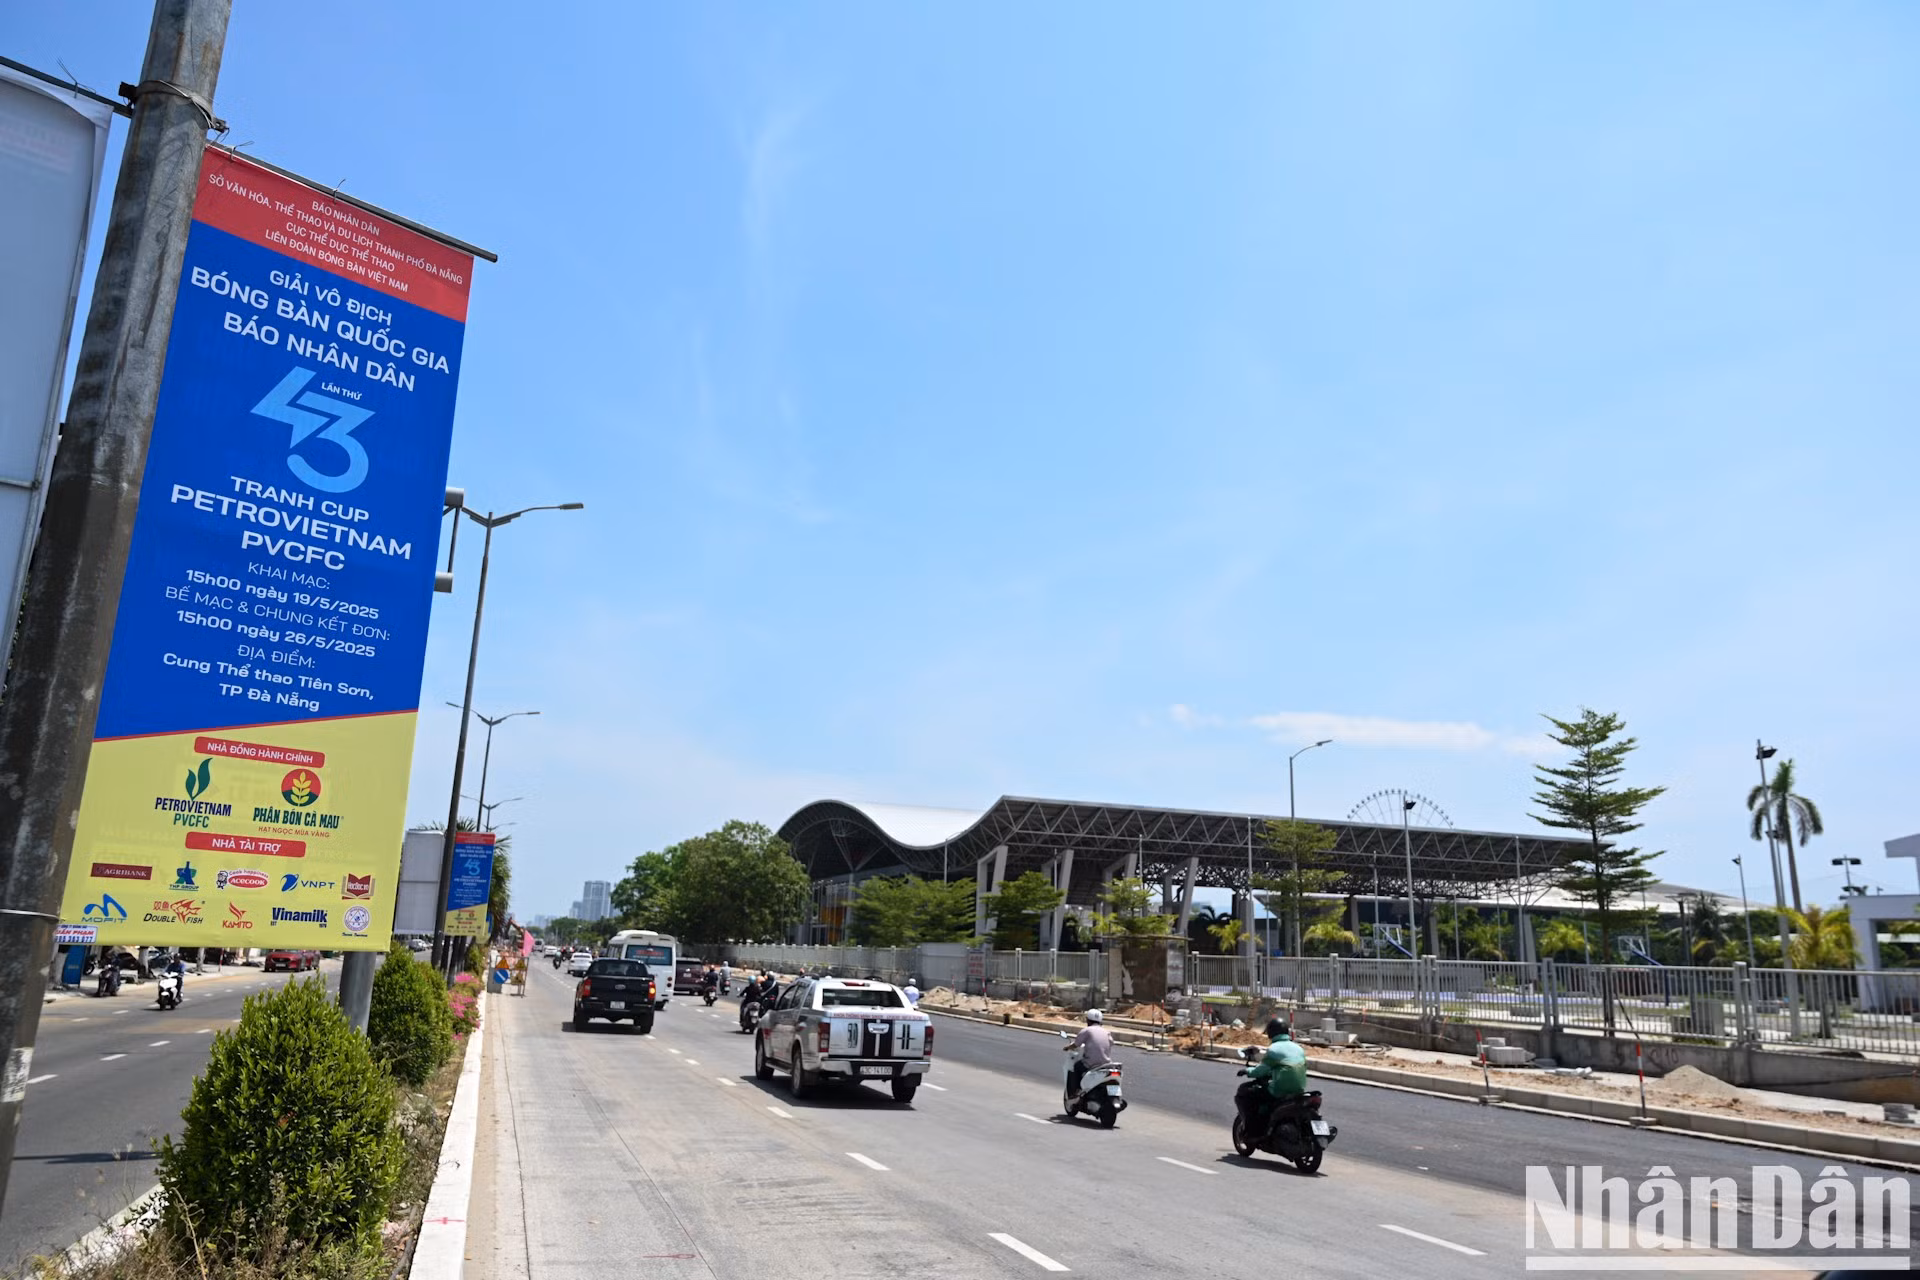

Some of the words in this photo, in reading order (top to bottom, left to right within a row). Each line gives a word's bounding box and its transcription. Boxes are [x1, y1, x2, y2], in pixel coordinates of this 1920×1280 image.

[208, 174, 224, 187] SỞ
[226, 180, 246, 197] VĂN
[275, 201, 295, 216] THỂ
[296, 209, 322, 227] THAO
[323, 219, 336, 233] VÀ
[337, 227, 351, 239] DU
[352, 232, 373, 249] LỊCH
[375, 241, 405, 261] THÀNH
[405, 255, 425, 269] PHỐ
[425, 263, 437, 275] ĐÀ
[439, 268, 463, 285] NẴNG
[312, 201, 332, 216] BÁO
[333, 210, 359, 227] NHÂN
[360, 221, 380, 236] DÂN
[265, 229, 287, 246] LIÊN
[289, 238, 316, 257] ĐOÀN
[318, 251, 345, 268] BÓNG
[346, 261, 366, 276] BÀN
[367, 269, 387, 284] VIỆT
[388, 277, 408, 292] NAM
[286, 222, 307, 237] CỤC
[309, 230, 329, 246] THỂ
[329, 238, 349, 253] DỤC
[351, 247, 370, 262] THỂ
[371, 255, 395, 271] THAO
[269, 269, 309, 296] GIẢI
[315, 285, 341, 307] VÔ
[346, 298, 392, 326] ĐỊCH
[191, 265, 269, 310] BÓNG
[276, 297, 330, 332] BÀN
[336, 320, 406, 358] QUỐC
[411, 346, 450, 375] GIA
[223, 311, 280, 346] BÁO
[286, 333, 359, 374] NHÂN
[365, 360, 416, 392] DÂN
[341, 388, 362, 401] THỨ
[250, 366, 376, 494] 43
[230, 475, 315, 511] TRANH
[320, 500, 370, 523] CUP
[170, 483, 412, 560] PETROVIETNAM
[241, 530, 346, 571] PVCFC
[247, 561, 287, 580] KHAI
[291, 571, 330, 590] MẠC:
[186, 569, 241, 591] 15h00
[245, 584, 288, 603] ngày
[293, 592, 379, 620] 19/5/2025
[165, 585, 191, 602] BẾ
[194, 591, 234, 610] MẠC
[237, 601, 249, 614] &
[254, 604, 314, 626] CHUNG
[318, 615, 348, 633] KẾT
[352, 623, 391, 641] ĐƠN:
[177, 610, 233, 631] 15h00
[237, 624, 280, 643] ngày
[284, 630, 376, 658] 26/5/2025
[237, 644, 266, 660] ĐỊA
[271, 649, 316, 669] ĐIỂM:
[163, 652, 211, 674] Cung
[216, 661, 251, 678] Thể
[254, 668, 293, 685] thao
[298, 675, 333, 692] Tiên
[337, 682, 375, 701] Sơn,
[219, 683, 243, 697] TP
[247, 688, 271, 702] Đà
[276, 691, 320, 712] Nẵng
[207, 742, 228, 753] NHÀ
[229, 744, 257, 756] ĐỒNG
[257, 749, 284, 760] HÀNH
[285, 751, 313, 764] CHÍNH
[155, 797, 232, 817] PETROVIETNAM
[173, 813, 210, 828] PVCFC
[253, 806, 280, 824] PHÂN
[282, 808, 302, 825] BÓN
[304, 810, 317, 827] CÀ
[319, 814, 340, 829] MAU
[211, 838, 236, 849] NHÀ
[239, 839, 255, 850] TÀI
[257, 841, 282, 854] TRỢ
[272, 827, 293, 835] NGỌC
[311, 830, 330, 838] VÀNG
[104, 868, 147, 877] AGRIBANK
[301, 880, 336, 889] VNPT
[81, 916, 127, 924] MOFIT
[143, 912, 177, 923] DOUBLE
[186, 916, 204, 924] FISH
[222, 920, 253, 929] KAMITO
[272, 907, 328, 923] Vinamilk
